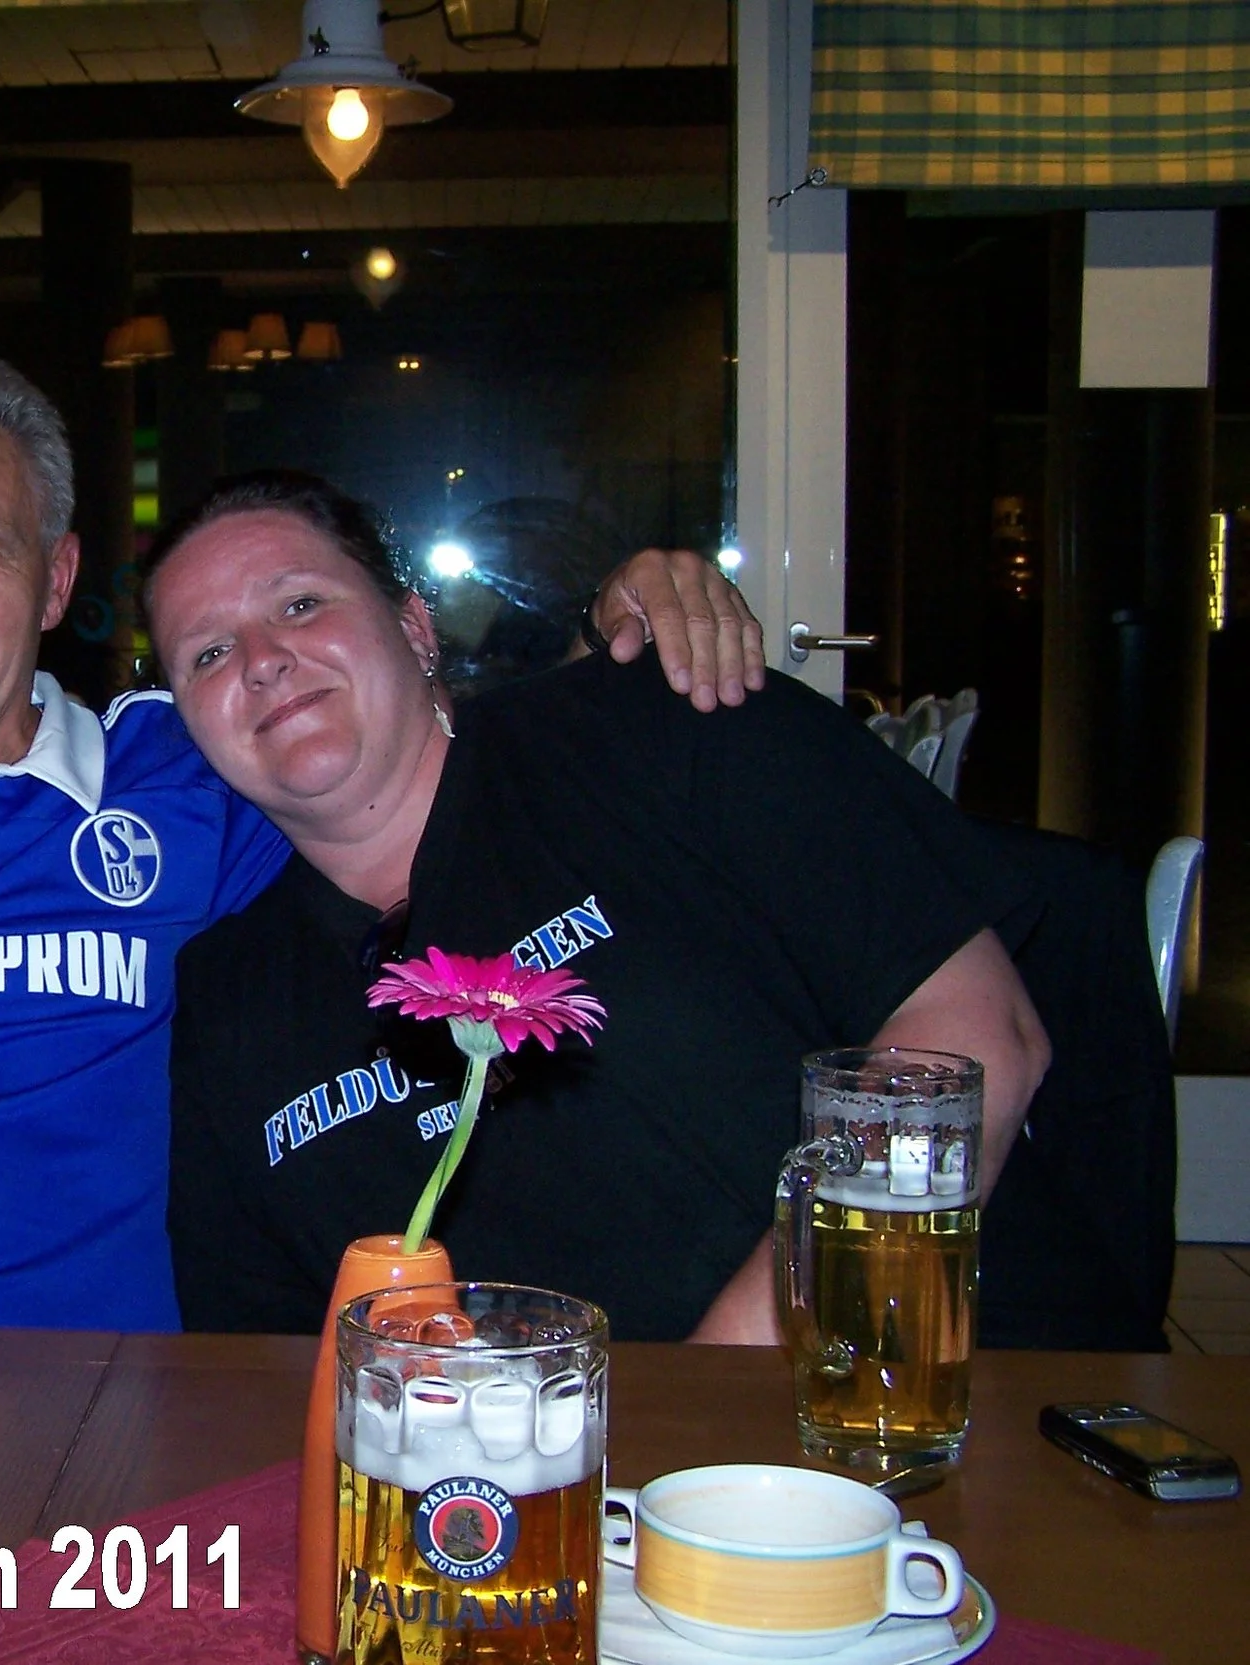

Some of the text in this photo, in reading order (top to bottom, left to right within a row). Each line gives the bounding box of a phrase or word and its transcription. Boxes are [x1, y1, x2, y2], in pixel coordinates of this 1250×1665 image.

[110, 865, 138, 893] 04
[418, 1481, 513, 1518] PAULANER
[425, 1549, 505, 1578] MÜNCHEN
